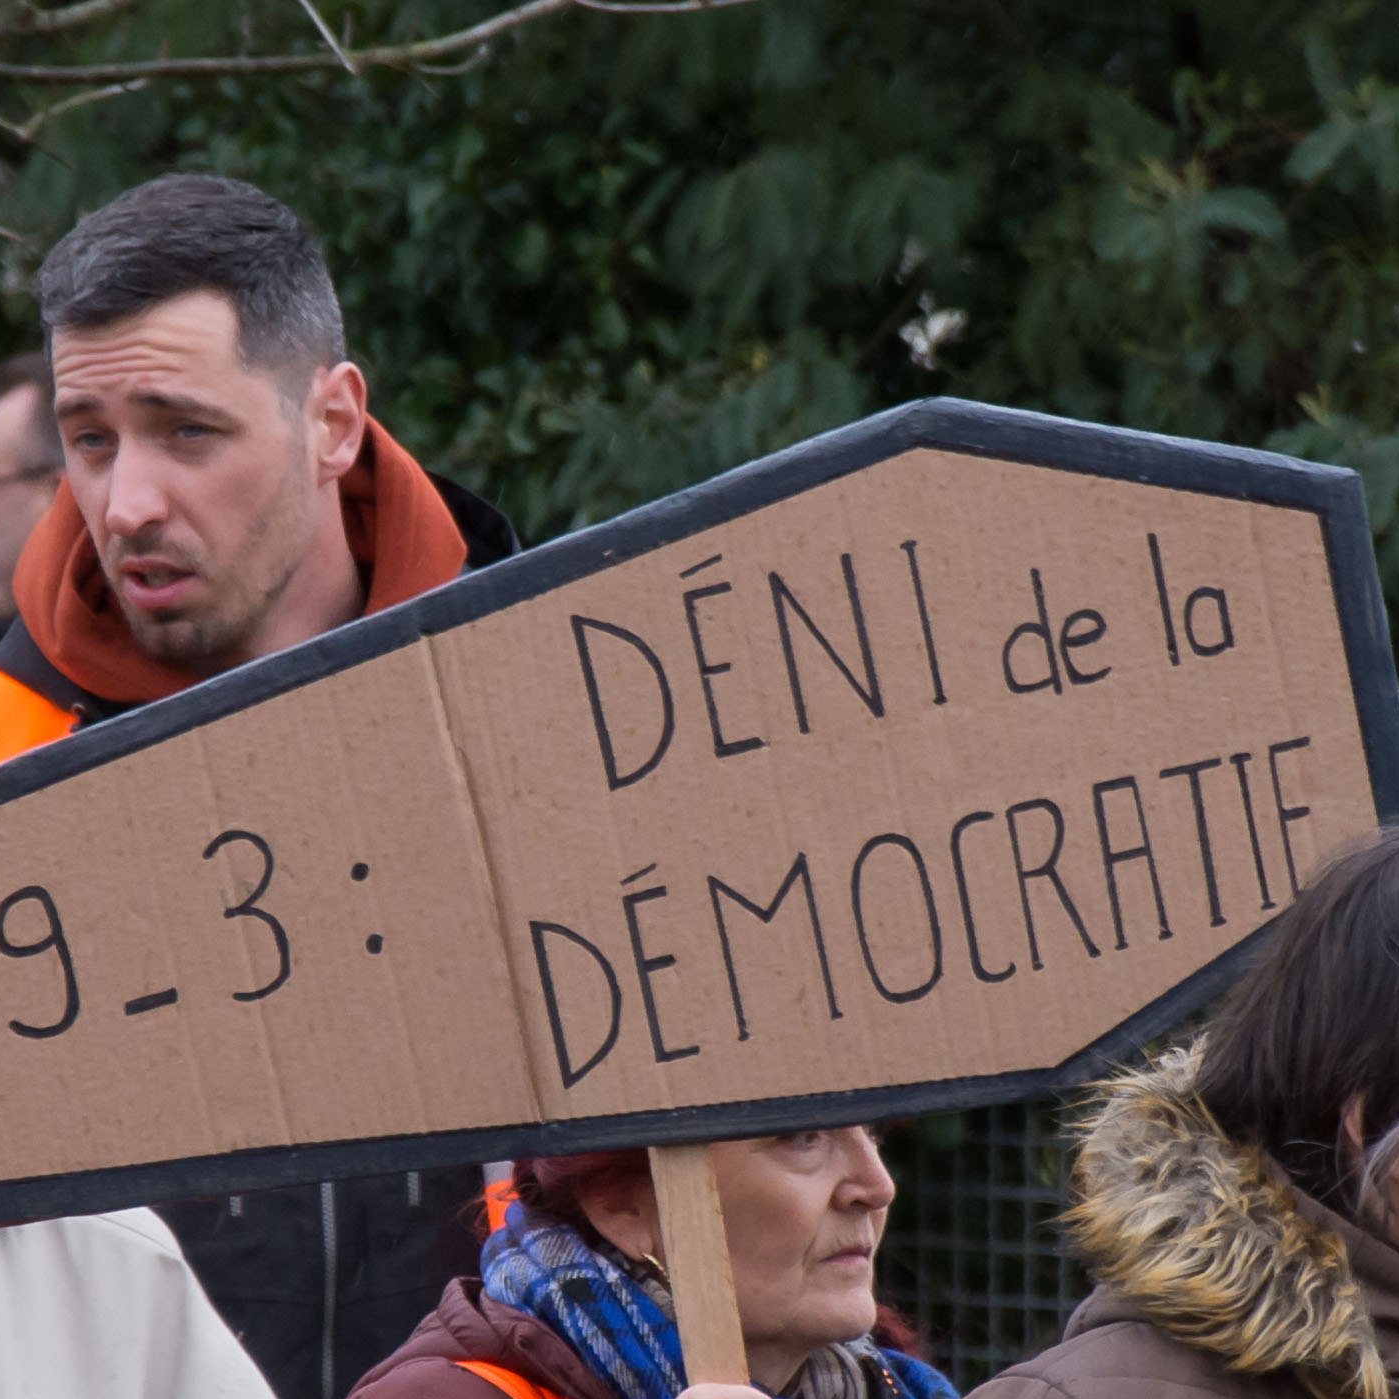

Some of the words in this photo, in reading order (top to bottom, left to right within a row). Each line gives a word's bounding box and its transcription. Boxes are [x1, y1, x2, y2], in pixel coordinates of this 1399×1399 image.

[571, 541, 948, 791] DÉNI
[1002, 567, 1113, 695] de
[1146, 532, 1235, 667] la
